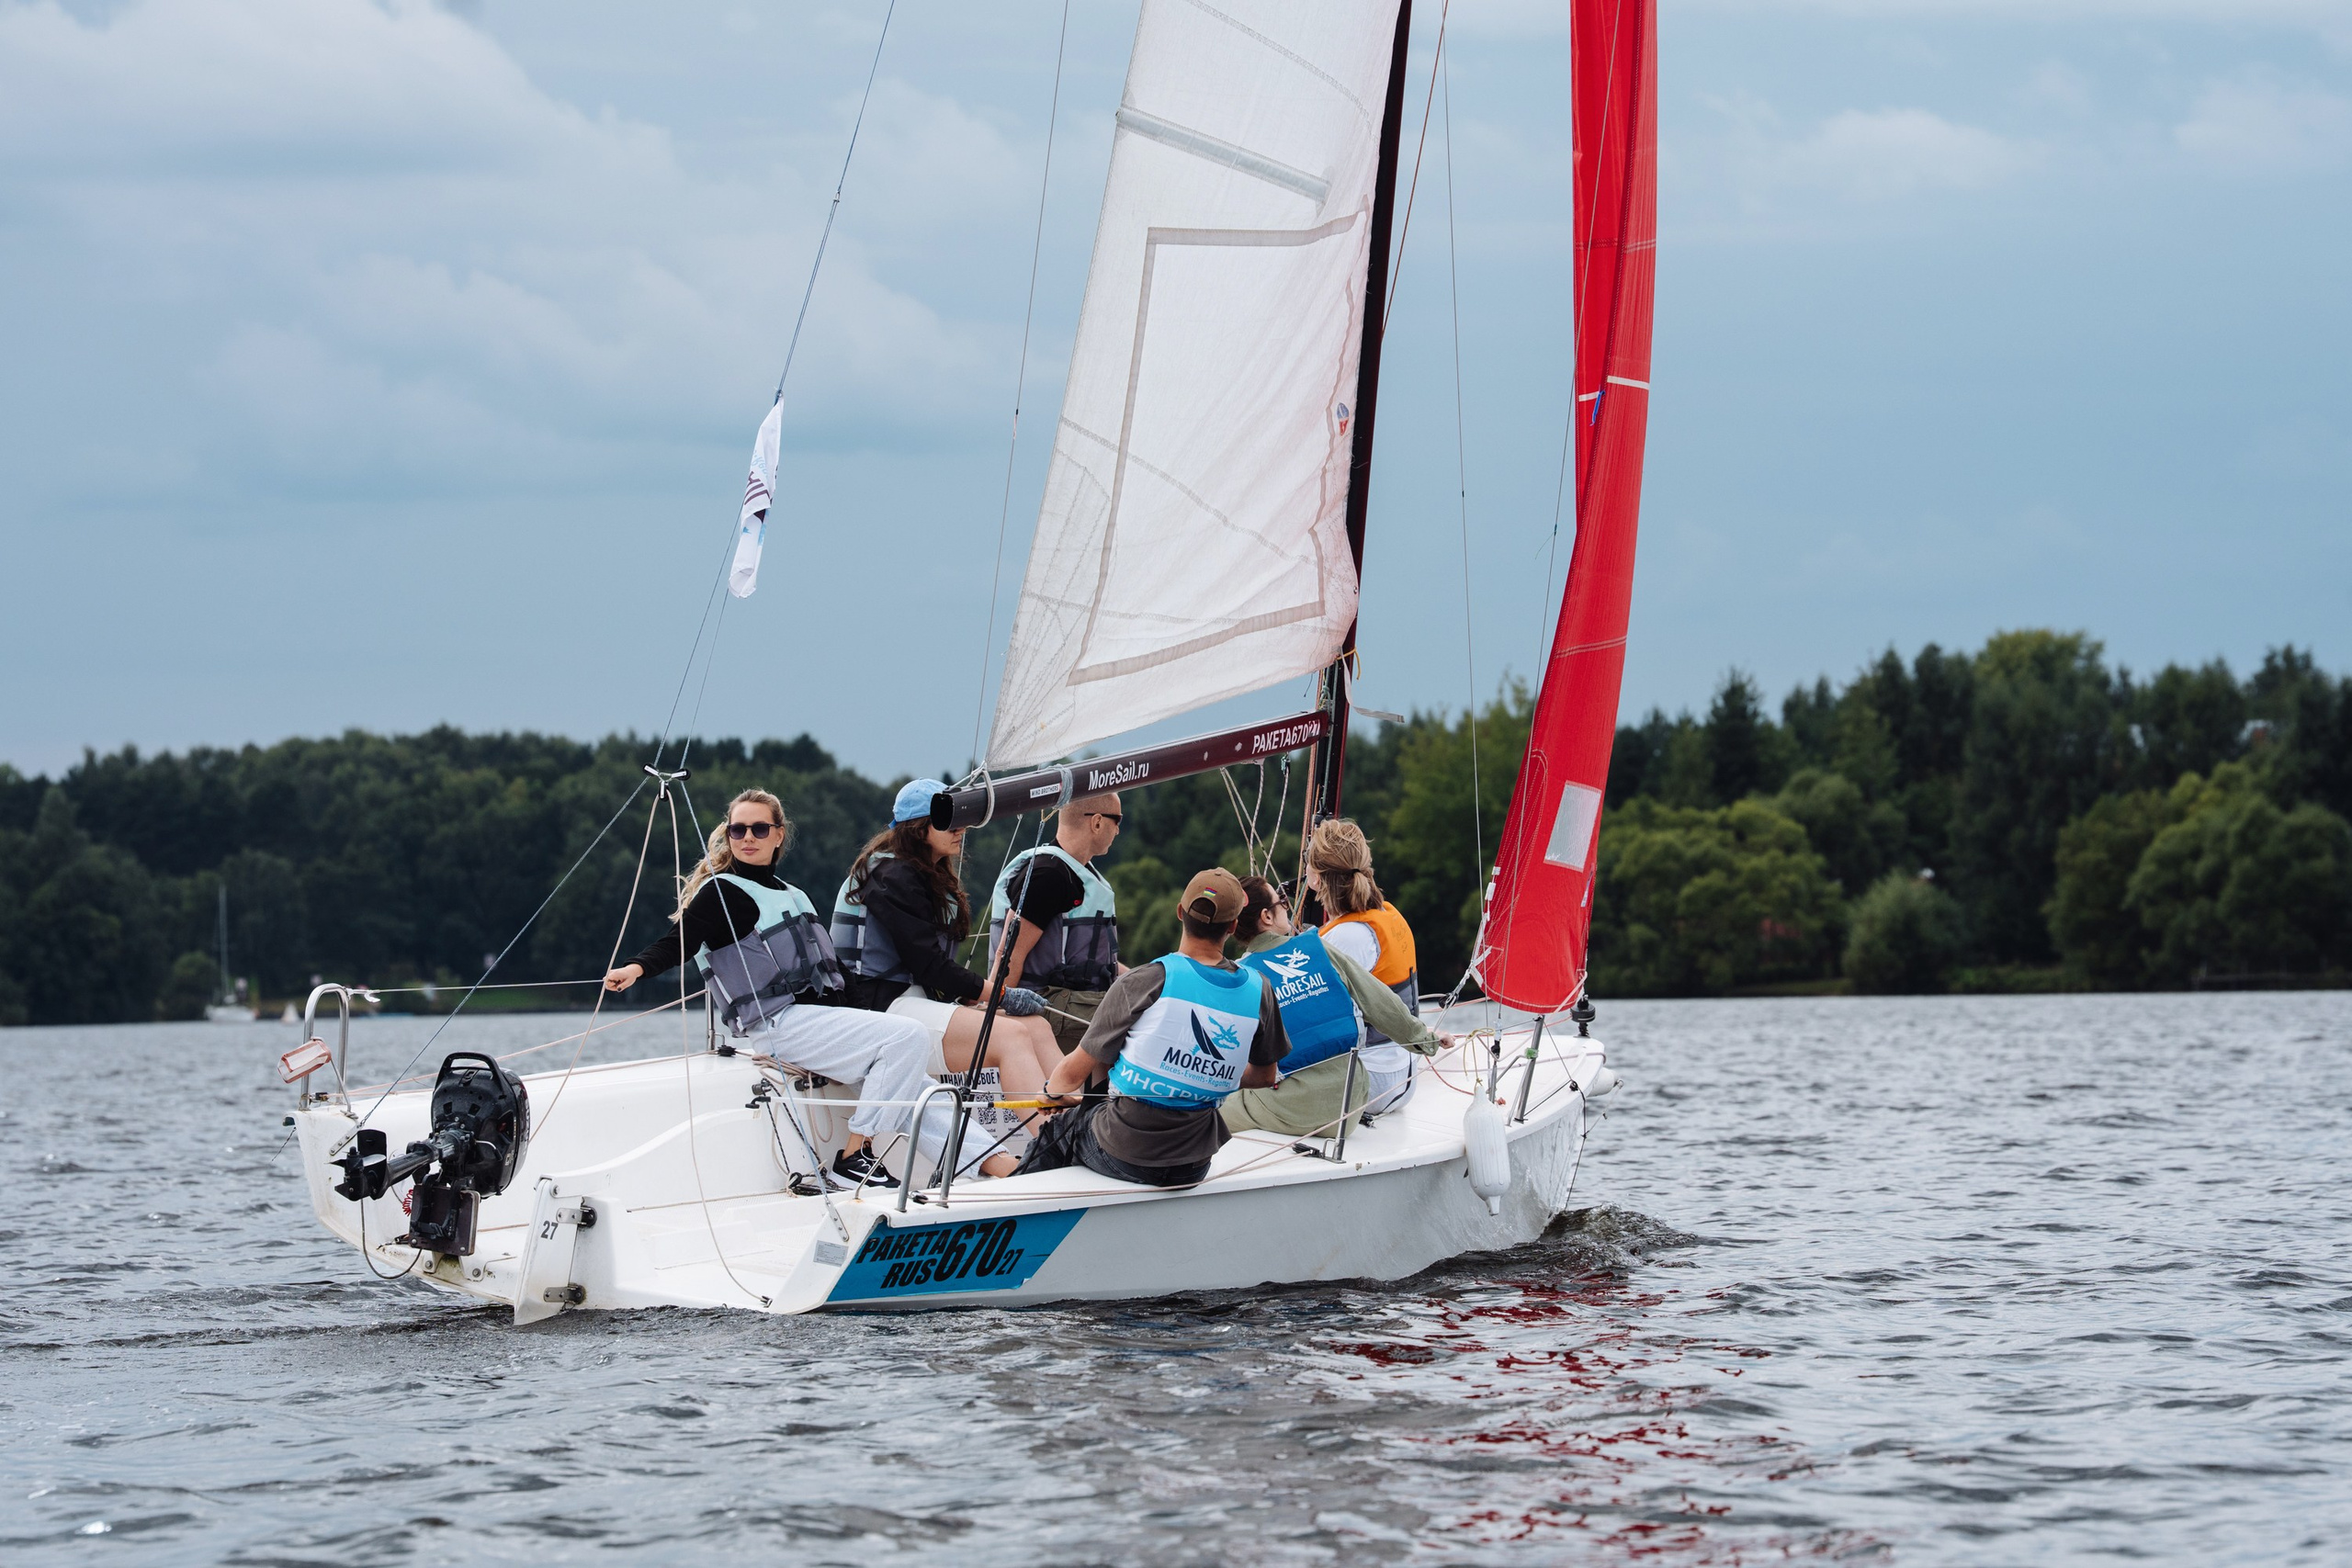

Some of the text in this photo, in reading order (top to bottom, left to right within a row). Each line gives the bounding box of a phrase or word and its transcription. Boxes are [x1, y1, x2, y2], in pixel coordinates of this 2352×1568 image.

[1088, 761, 1149, 791] MoreSail.ru
[1279, 999, 1291, 1009] aces
[1159, 1062, 1181, 1075] Races
[1183, 1070, 1205, 1083] Events
[1163, 1046, 1236, 1080] MORESAIL
[540, 1220, 559, 1240] 27
[880, 1258, 937, 1289] RUS
